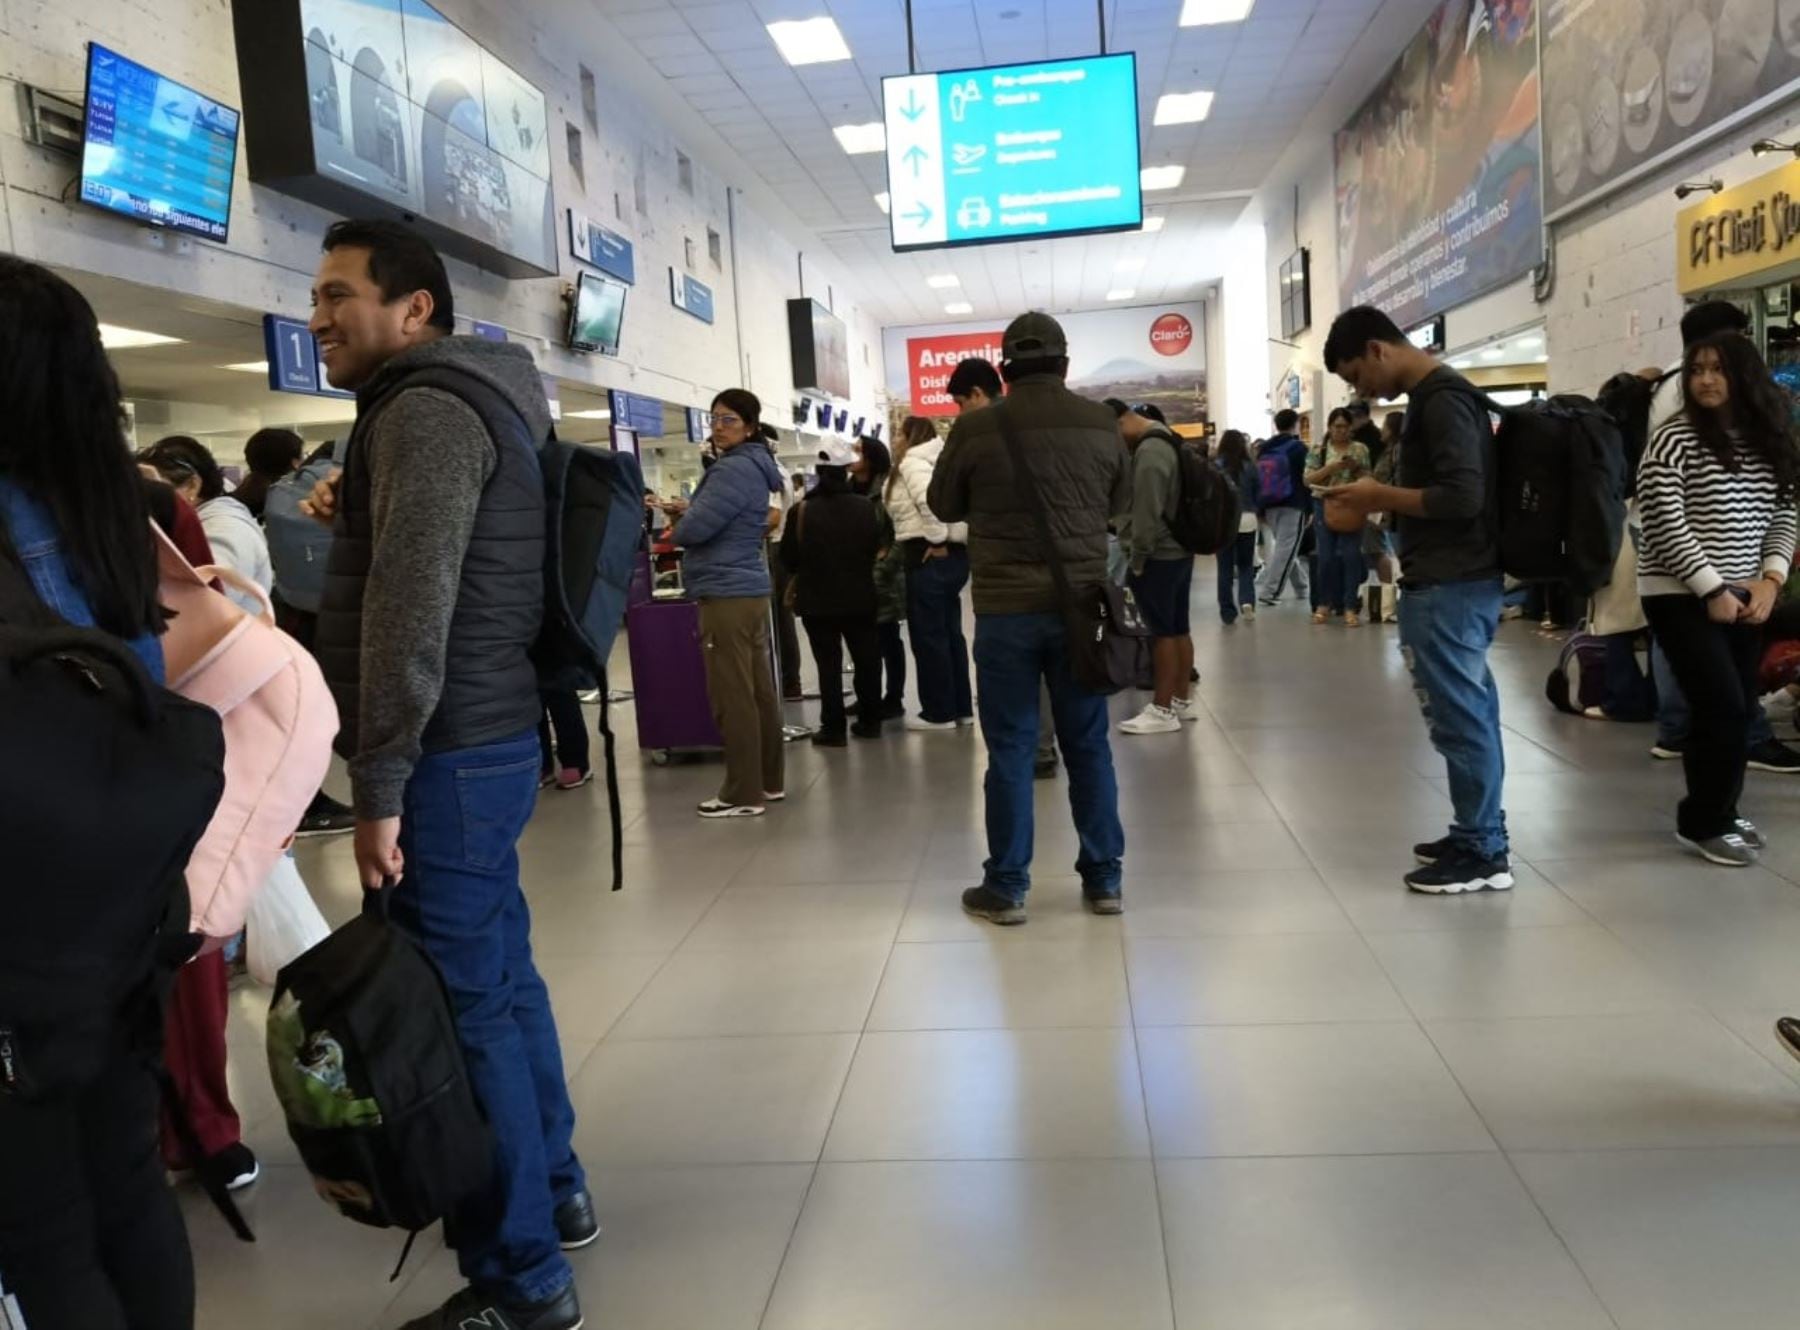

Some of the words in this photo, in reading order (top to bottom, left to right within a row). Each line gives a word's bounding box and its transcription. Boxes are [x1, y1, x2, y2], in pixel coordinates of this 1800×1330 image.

[1450, 199, 1509, 250] contribuimos
[290, 332, 302, 369] 1
[1152, 328, 1185, 341] Claro
